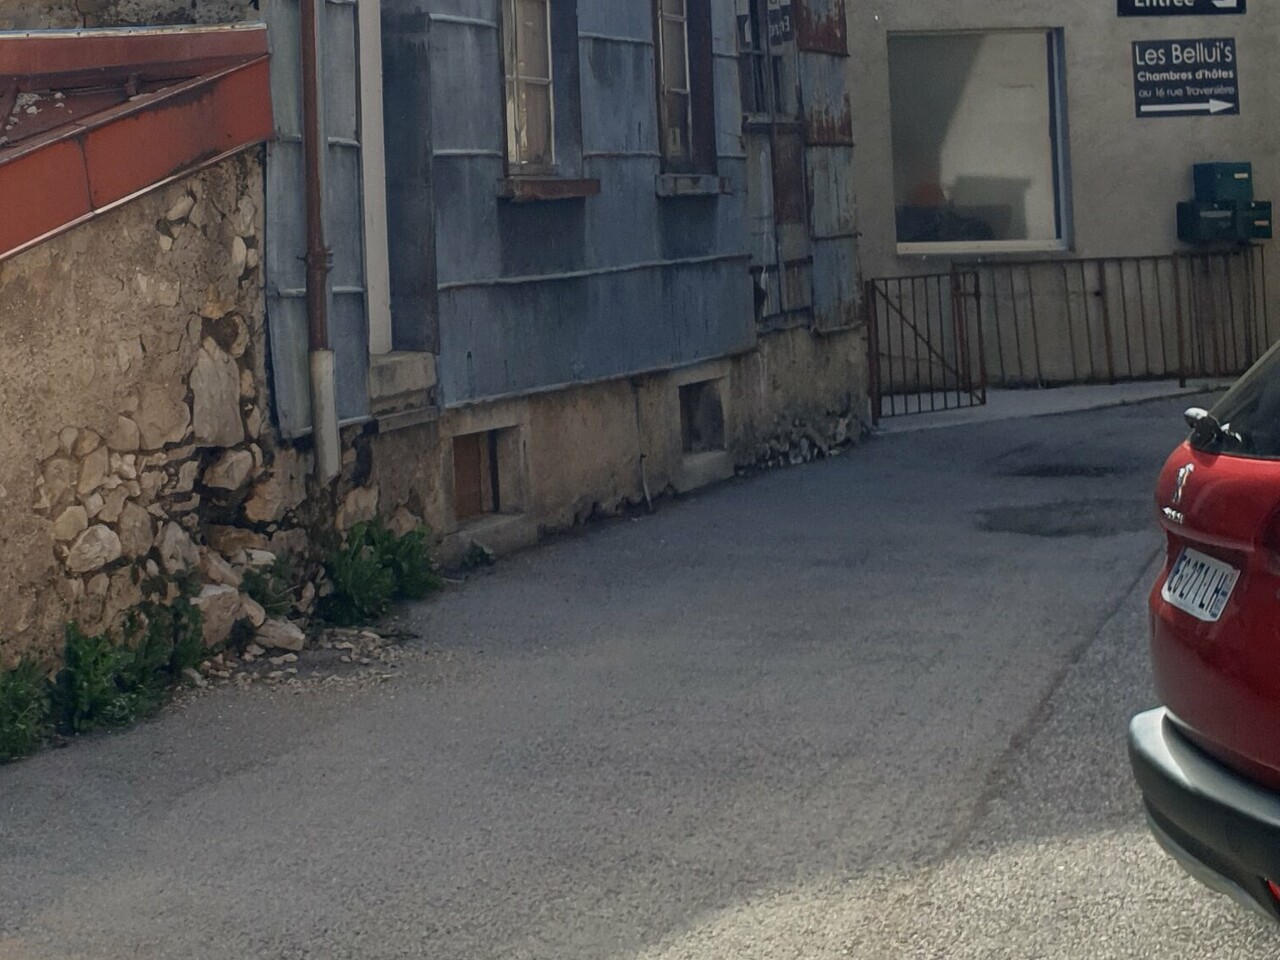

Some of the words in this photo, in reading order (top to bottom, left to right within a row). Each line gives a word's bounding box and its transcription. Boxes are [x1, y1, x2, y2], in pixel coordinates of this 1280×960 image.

[1135, 45, 1166, 66] Les
[1171, 42, 1232, 64] Bellui's
[1137, 70, 1192, 81] Chambres
[1195, 68, 1234, 79] d'hôtes
[1138, 88, 1151, 97] au
[1155, 87, 1165, 96] 16
[1166, 88, 1183, 96] rue
